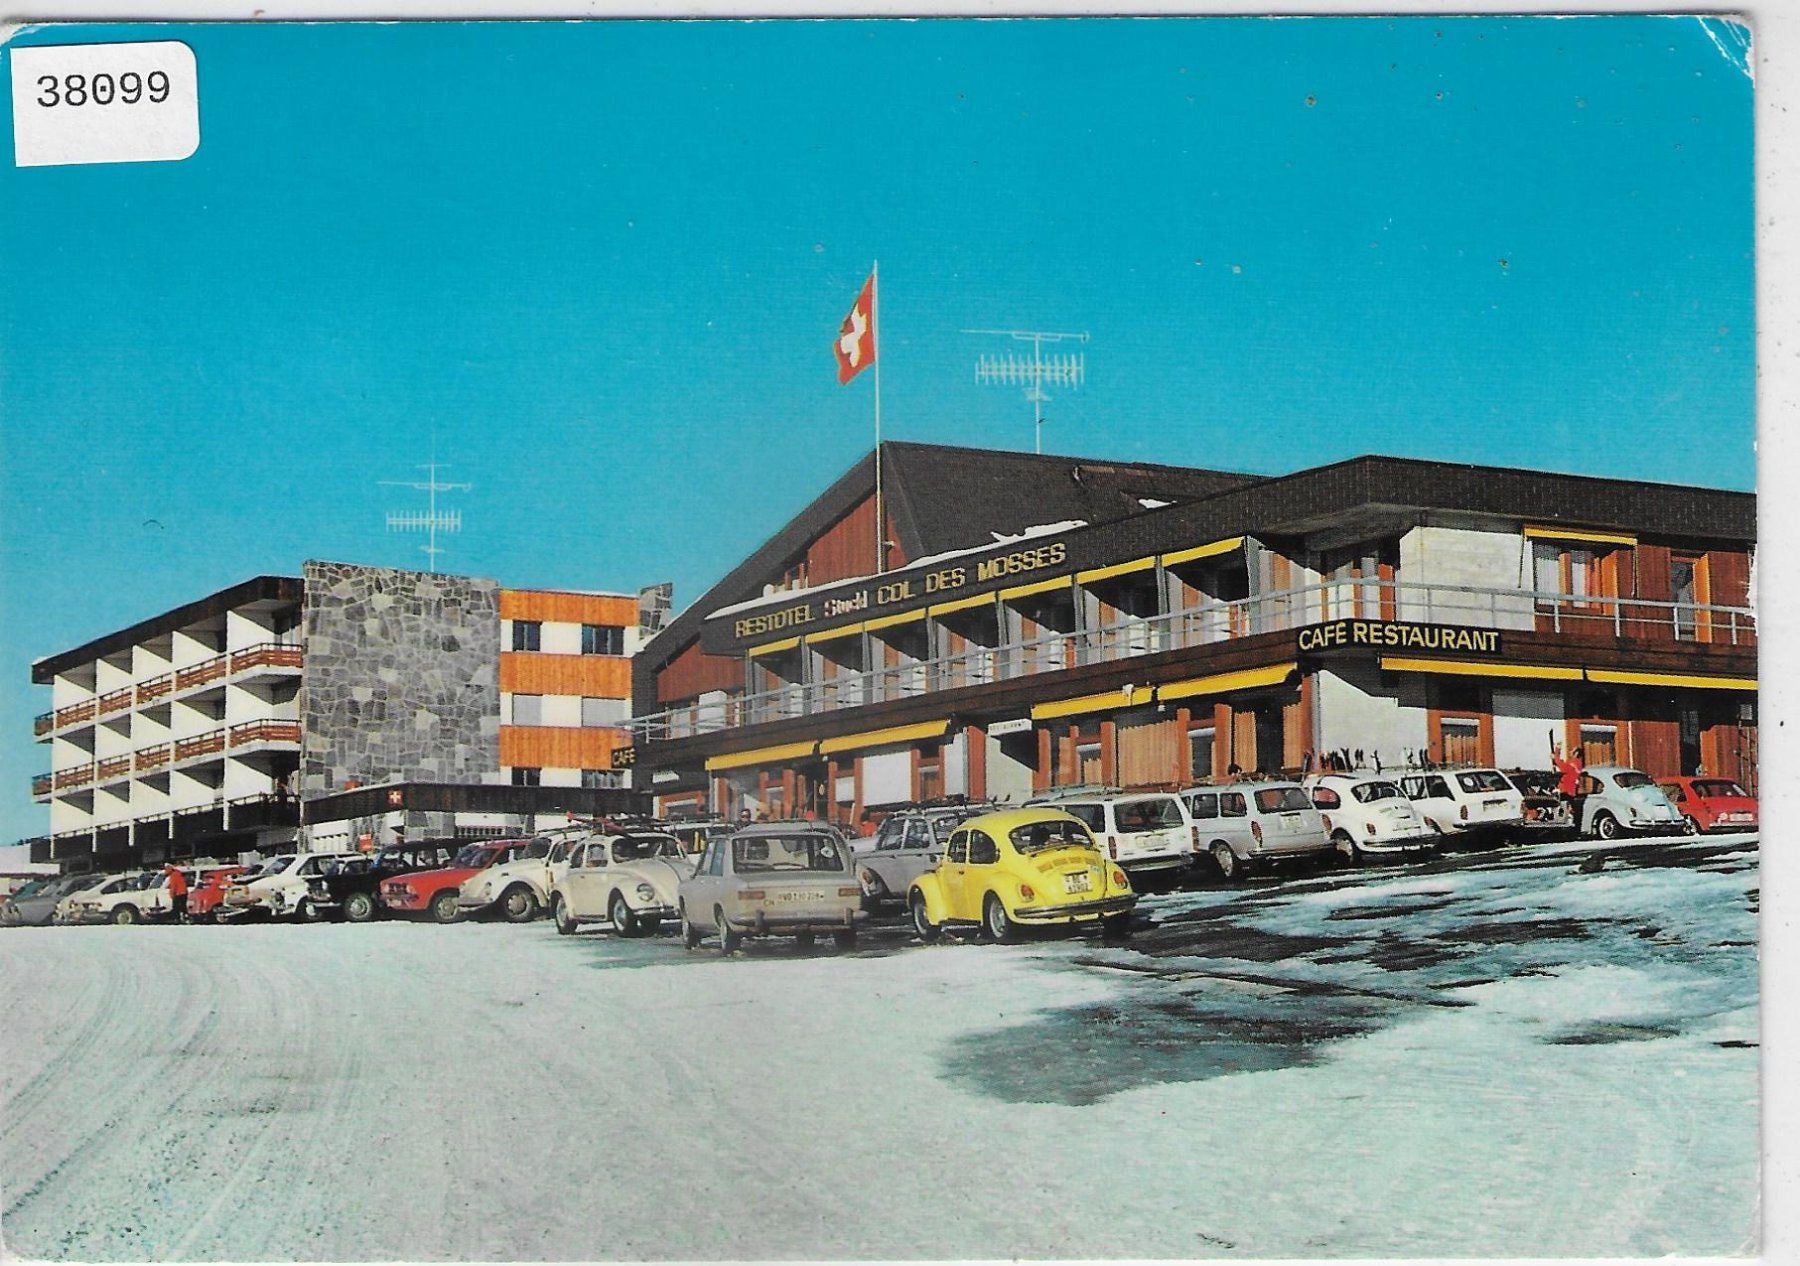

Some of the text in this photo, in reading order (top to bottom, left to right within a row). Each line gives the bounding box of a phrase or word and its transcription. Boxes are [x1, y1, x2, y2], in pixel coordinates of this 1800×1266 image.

[37, 71, 170, 107] 38099
[736, 604, 816, 638] RESTOTEL
[877, 581, 916, 605] COL
[925, 567, 966, 593] DES
[977, 542, 1067, 581] MOSSES
[1353, 622, 1498, 651] RESTAURANT
